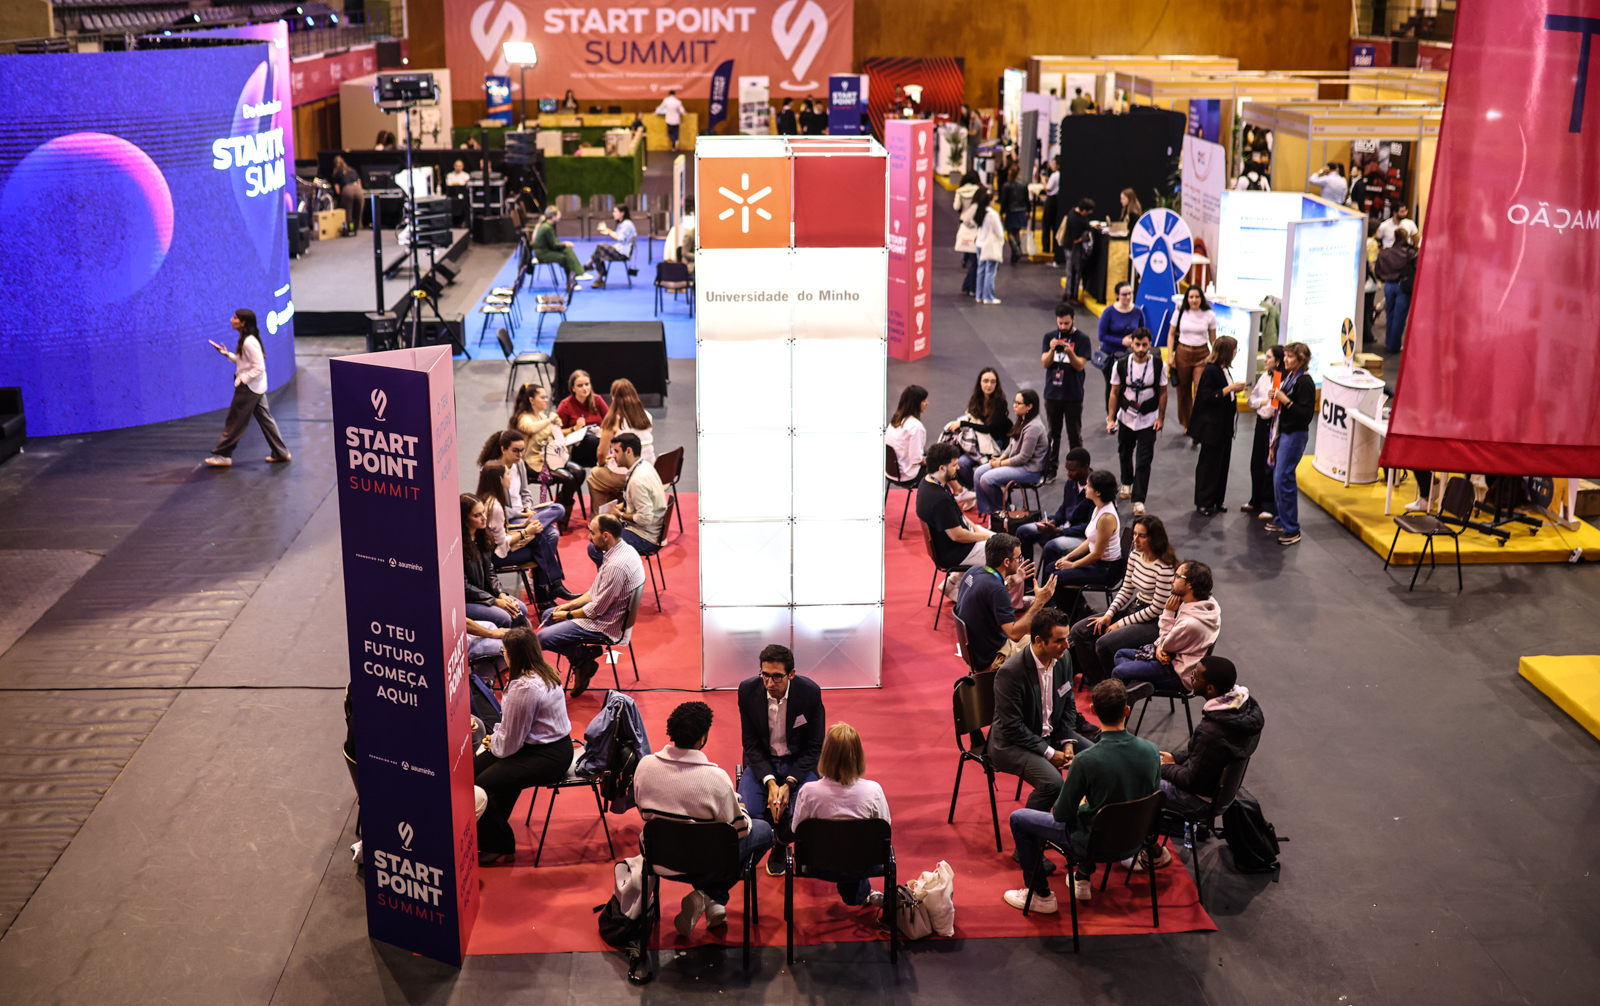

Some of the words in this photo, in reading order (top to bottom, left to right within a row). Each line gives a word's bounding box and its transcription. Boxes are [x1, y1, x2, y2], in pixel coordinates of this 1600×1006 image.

[544, 8, 649, 34] START
[656, 7, 756, 33] POINT
[585, 40, 717, 65] SUMMIT
[832, 91, 858, 99] START
[706, 291, 789, 302] Universidade
[797, 290, 813, 301] do
[819, 290, 860, 301] Minho
[1322, 398, 1347, 430] CJR
[345, 426, 419, 457] START
[349, 448, 418, 480] POINT
[349, 475, 421, 501] SUMMIT
[398, 561, 424, 572] aauminho
[370, 620, 382, 635] O
[386, 624, 416, 643] TEU
[364, 640, 425, 666] FUTURO
[447, 630, 465, 682] START
[363, 661, 428, 690] COMEÇA
[448, 652, 465, 703] POINT
[376, 685, 418, 707] AQUI!
[410, 765, 436, 777] aauminho
[374, 849, 444, 883] START
[376, 873, 443, 907] POINT
[377, 892, 445, 925] SUMMIT
